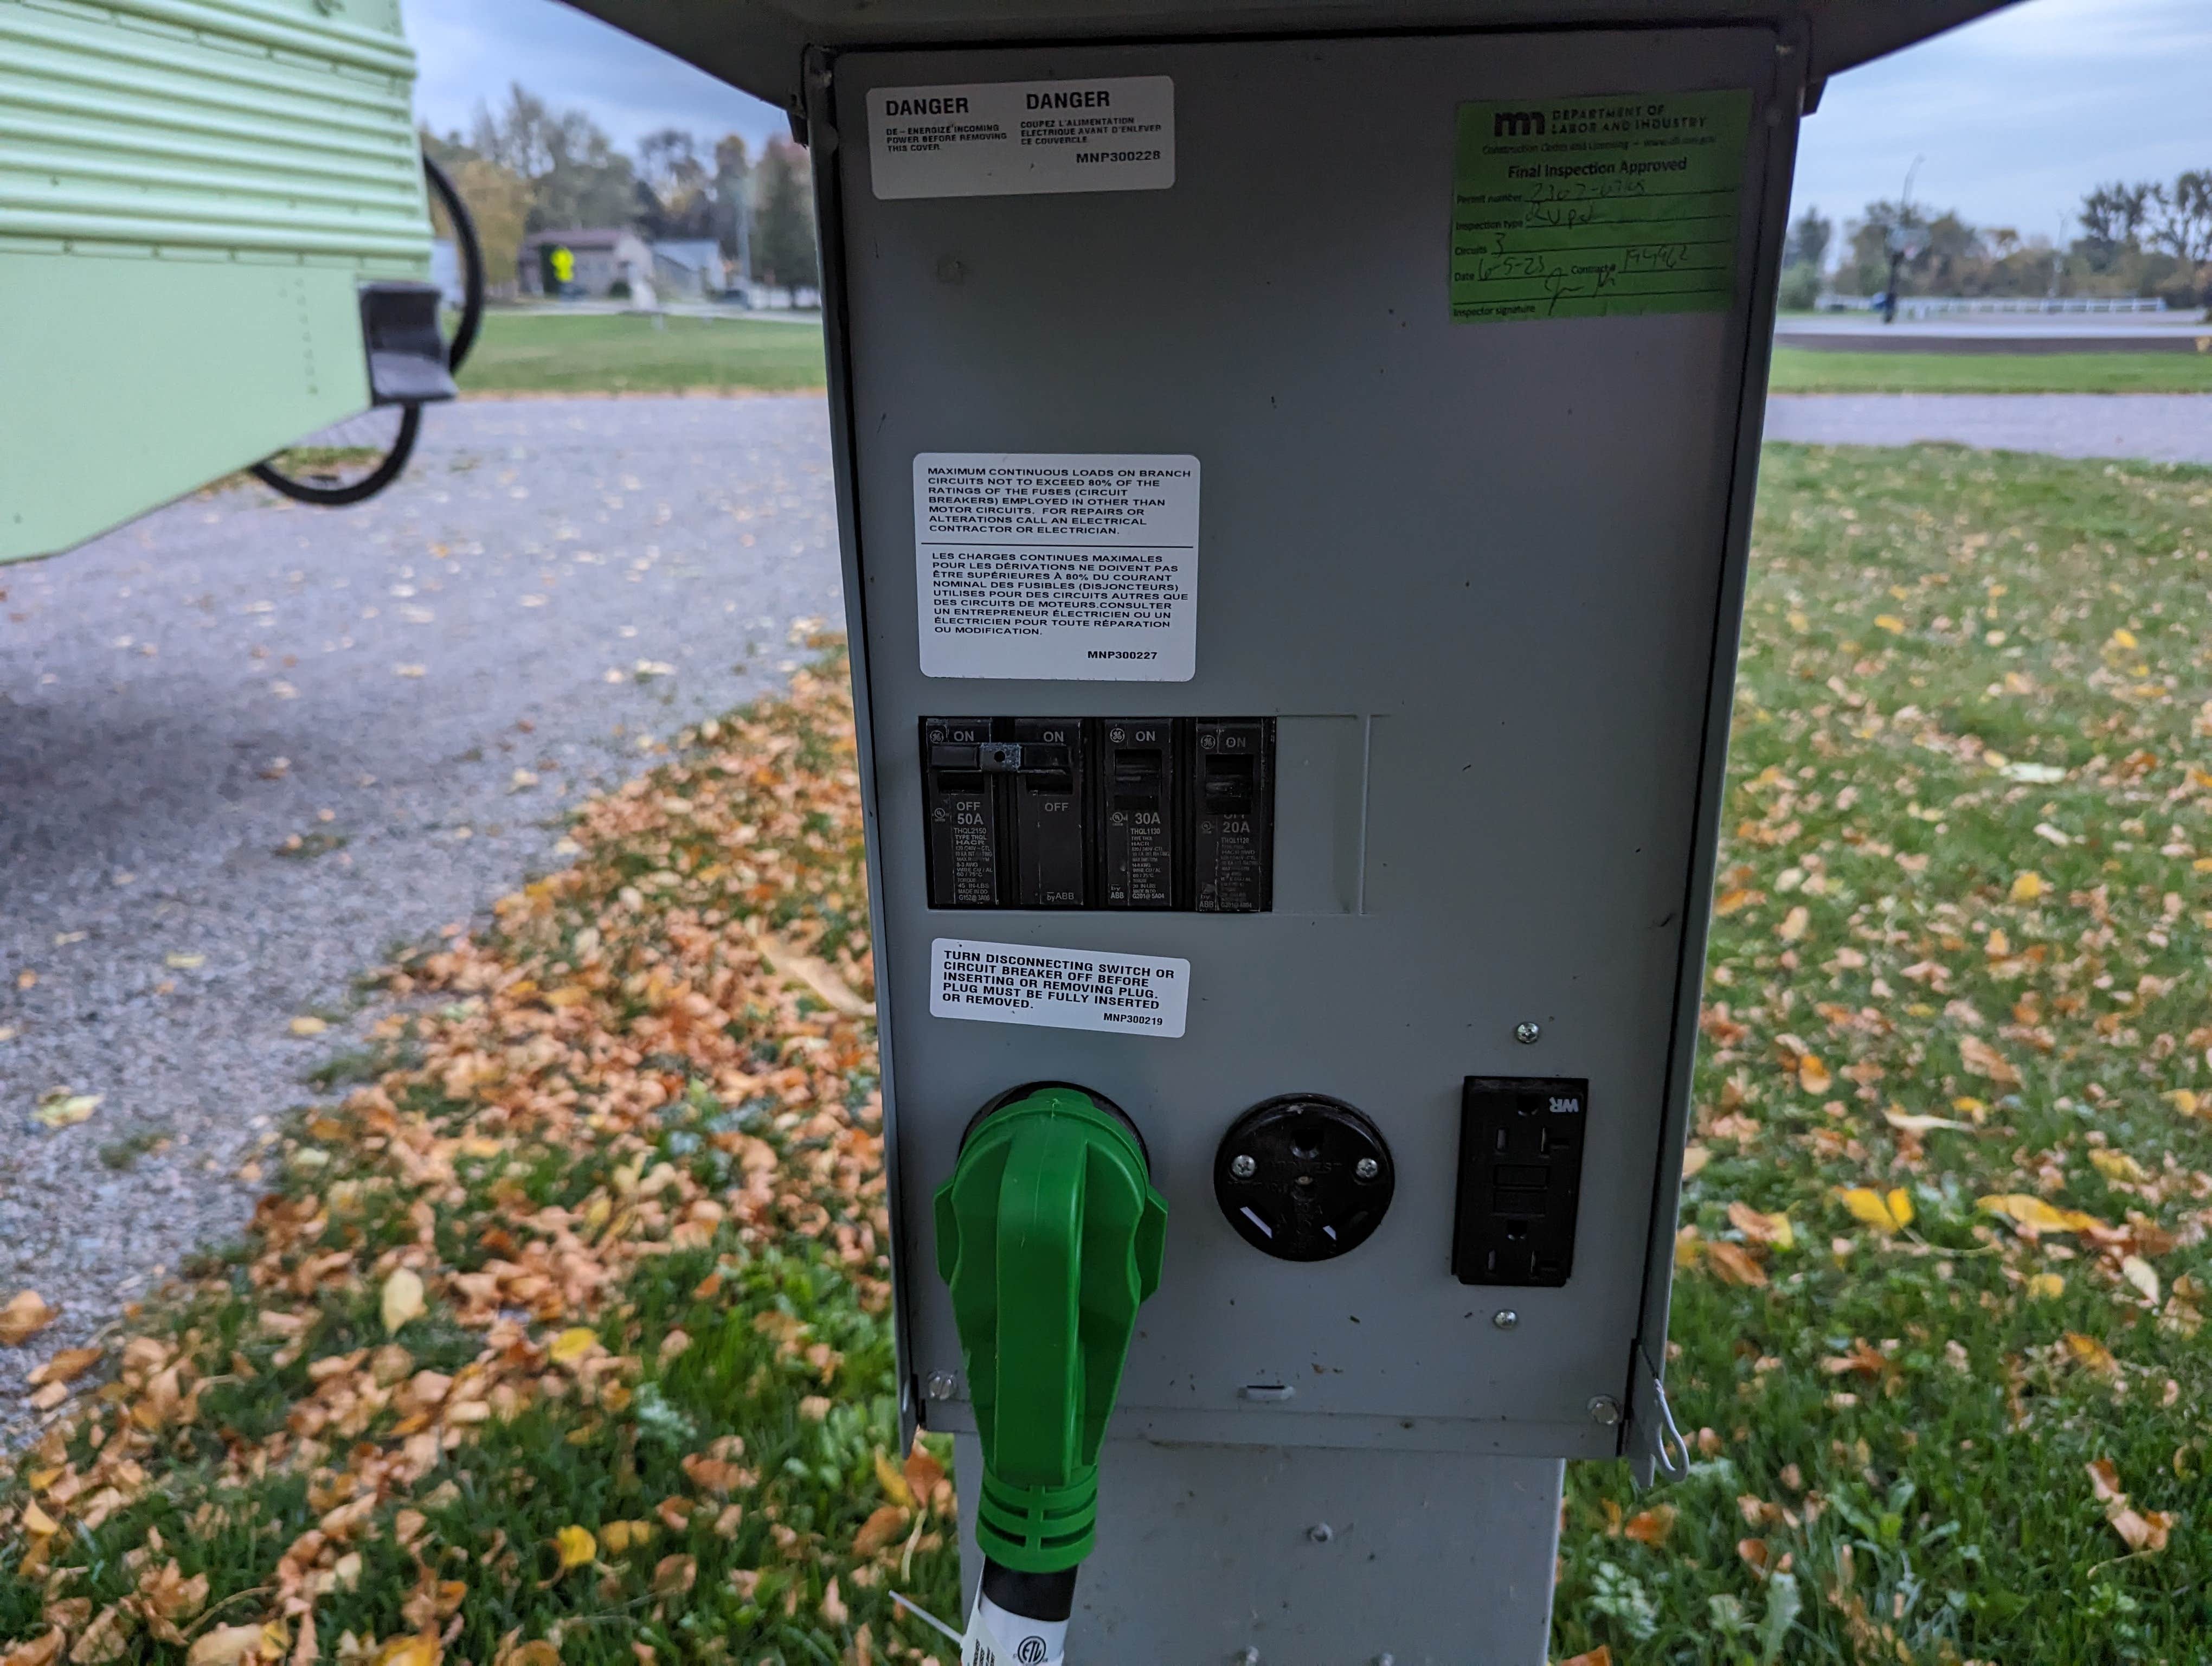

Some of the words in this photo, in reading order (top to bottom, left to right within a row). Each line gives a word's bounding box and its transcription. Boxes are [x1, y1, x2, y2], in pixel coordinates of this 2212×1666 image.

[1026, 91, 1109, 109] DANGER
[885, 97, 968, 116] DANGER
[1553, 107, 1640, 120] DEPARTMENT
[1648, 104, 1664, 116] OF
[954, 124, 999, 133] INCOMING
[1020, 119, 1055, 129] COUPEZ
[1059, 117, 1134, 127] L'ALIMENTATION
[1552, 123, 1596, 135] LABOR
[1603, 120, 1630, 132] AND
[1636, 116, 1706, 130] INDUSTRY
[886, 136, 919, 144] POWER
[922, 134, 956, 142] BEFORE
[959, 132, 1007, 141] REMOVING
[1034, 136, 1087, 144] COUVERCLE
[910, 143, 940, 151] COVER
[1076, 150, 1160, 163] MNP300228
[1508, 164, 1541, 178] Final
[1545, 163, 1615, 180] Inspection
[1621, 157, 1687, 174] Approved
[1457, 195, 1486, 204] Permit
[1488, 194, 1522, 203] number
[1456, 220, 1500, 231] Inspection
[1503, 220, 1523, 229] type
[1455, 246, 1488, 255] Circuits
[1454, 272, 1474, 281] Date
[1454, 307, 1493, 317] Inspector
[1495, 305, 1535, 315] signature
[988, 468, 1068, 476] CONTINUOUS
[1075, 489, 1128, 497] (CIRCUIT
[1037, 526, 1119, 534] ELECTRICIAN.
[995, 562, 1075, 571] DÉRIVATIONS
[933, 569, 963, 578] ÊTRE
[967, 571, 1050, 579] SUPÉRIEURES
[1053, 572, 1062, 580] À
[1078, 583, 1178, 592] (DISJONCTEURS)
[934, 616, 1010, 625] ÉLECTRICIEN
[1094, 619, 1169, 627] RÉPARATION
[955, 626, 1042, 635] MODIFICATION.
[1087, 650, 1157, 659] MNP300227
[954, 731, 974, 742] ON
[1043, 731, 1064, 742] ON
[1135, 731, 1155, 742] ON
[1225, 736, 1246, 748] ON
[956, 802, 981, 811] OFF
[1044, 803, 1069, 812] OFF
[957, 813, 984, 825] 50A
[1135, 812, 1161, 824] 30A
[1223, 821, 1250, 834] 20A
[1047, 893, 1055, 901] by
[1056, 892, 1075, 900] ABB
[944, 950, 980, 962] TURN
[986, 953, 1092, 971] DISCONNECTING
[1098, 964, 1150, 976] SWITCH
[1155, 969, 1174, 978] OR
[943, 961, 994, 973] CIRCUIT
[1001, 965, 1062, 979] BREAKER
[1068, 972, 1092, 982] OFF
[1097, 974, 1149, 987] BEFORE
[943, 971, 1014, 986] INSERTING
[1019, 978, 1037, 988] OR
[1043, 980, 1113, 995] REMOVING
[1118, 986, 1158, 998] PLUG.
[942, 992, 960, 1002] OR
[966, 994, 1033, 1009] REMOVED.
[943, 982, 978, 993] PLUG
[983, 985, 1020, 997] MUST
[1026, 989, 1043, 999] BE
[1047, 991, 1089, 1003] FULLY
[1094, 995, 1159, 1009] INSERTED
[1103, 1013, 1162, 1025] MNP300219
[1548, 1096, 1579, 1113] WR
[1021, 1638, 1044, 1663] ETL
